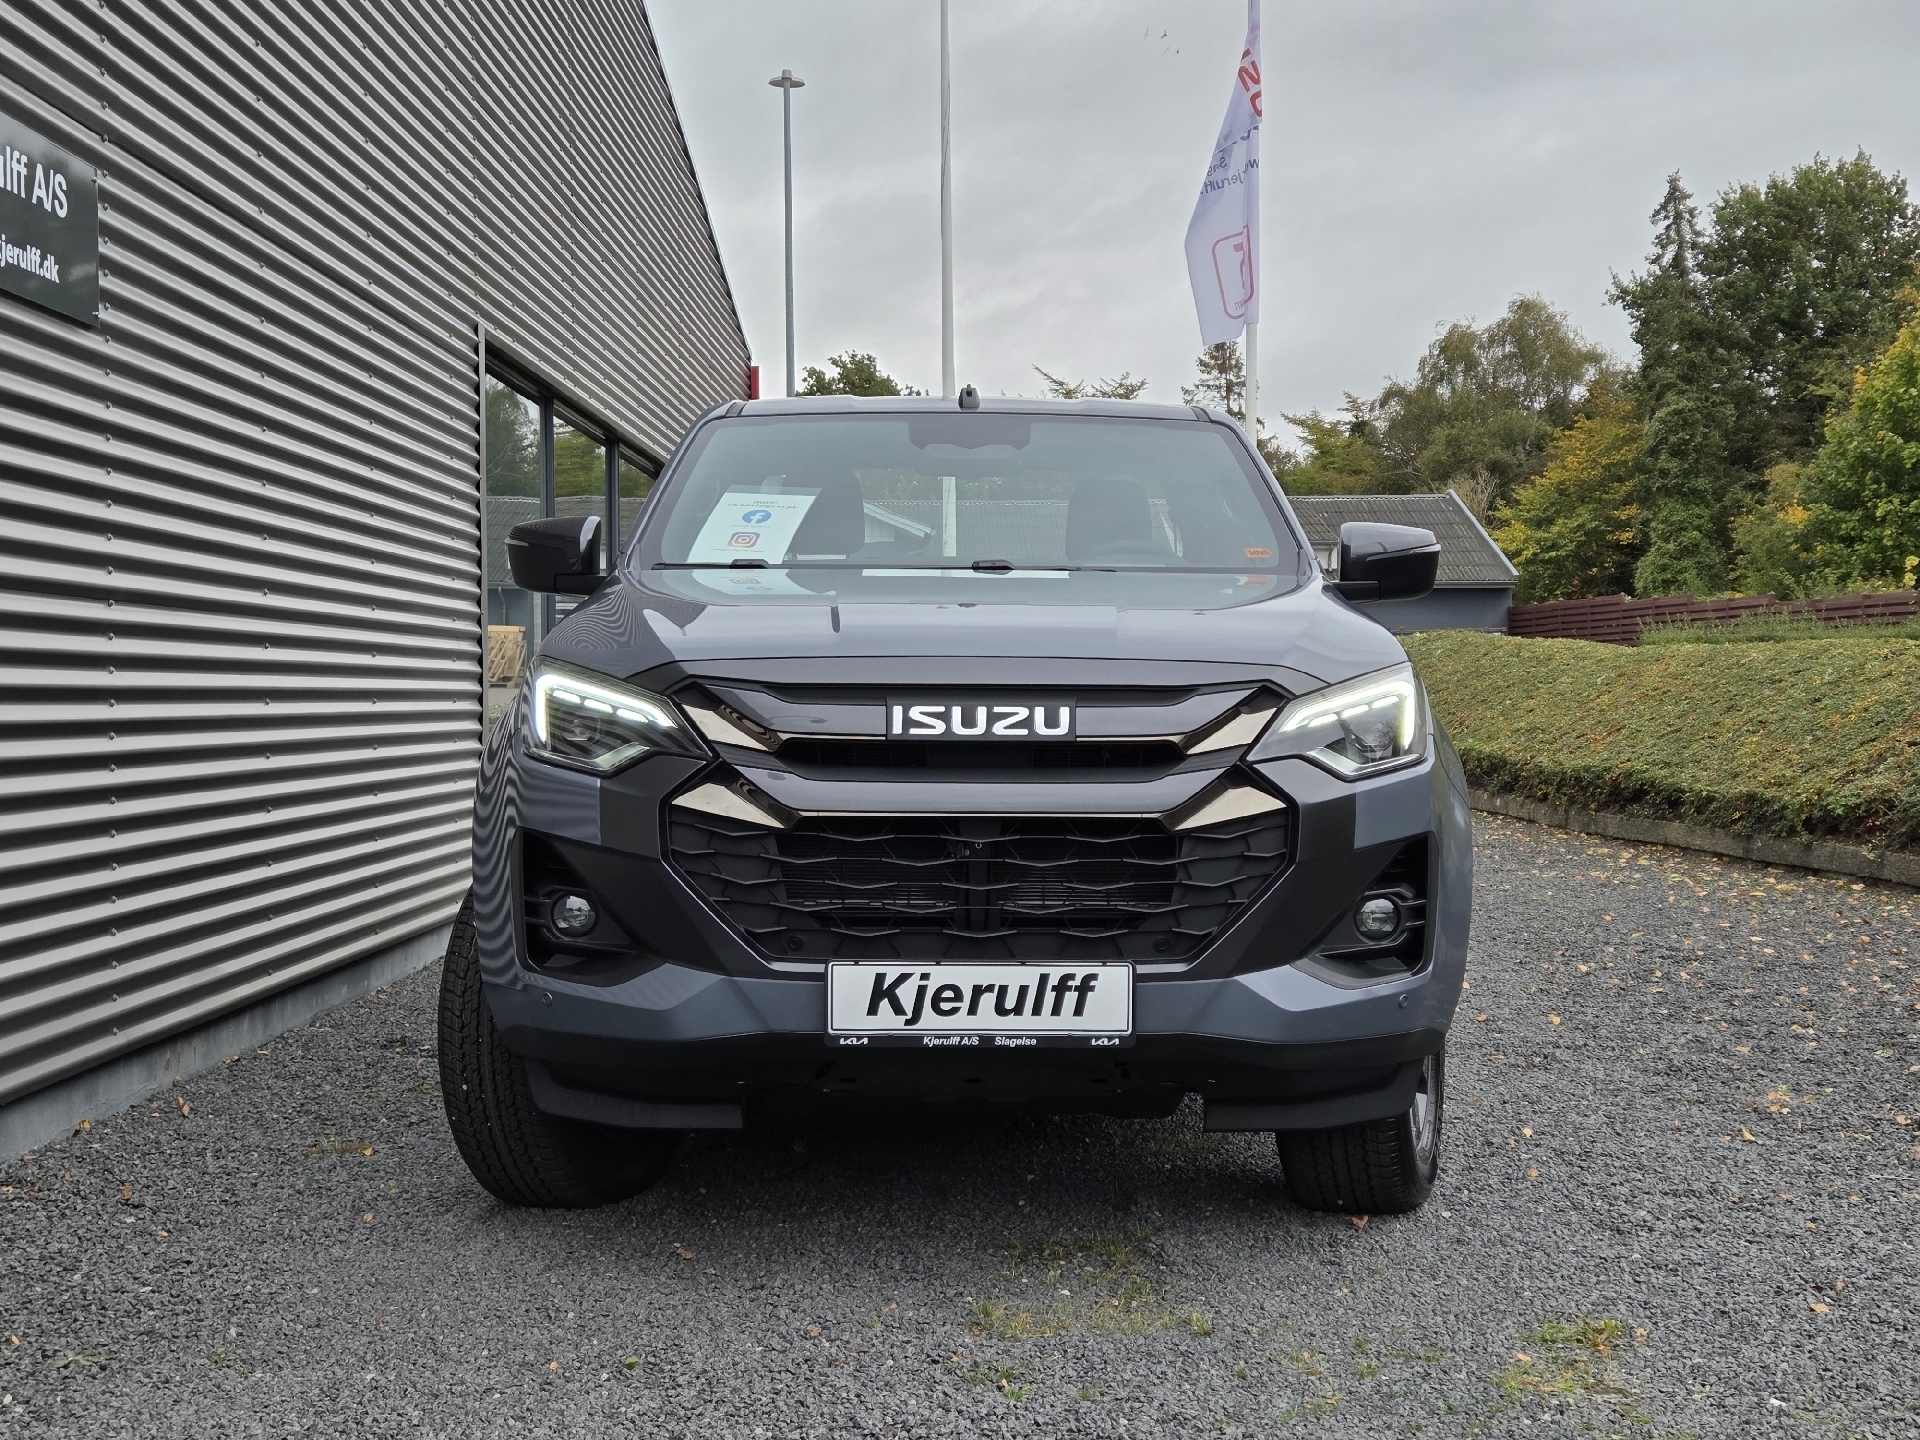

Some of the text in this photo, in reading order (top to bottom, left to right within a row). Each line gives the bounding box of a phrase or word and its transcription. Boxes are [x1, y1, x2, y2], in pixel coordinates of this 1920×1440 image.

[32, 162, 68, 218] A/S
[891, 705, 1070, 736] ISUZU
[866, 972, 1099, 1027] Kjerulff
[923, 1036, 961, 1047] Kjerulff
[961, 1036, 980, 1046] A/S
[994, 1036, 1037, 1047] Slagelse
